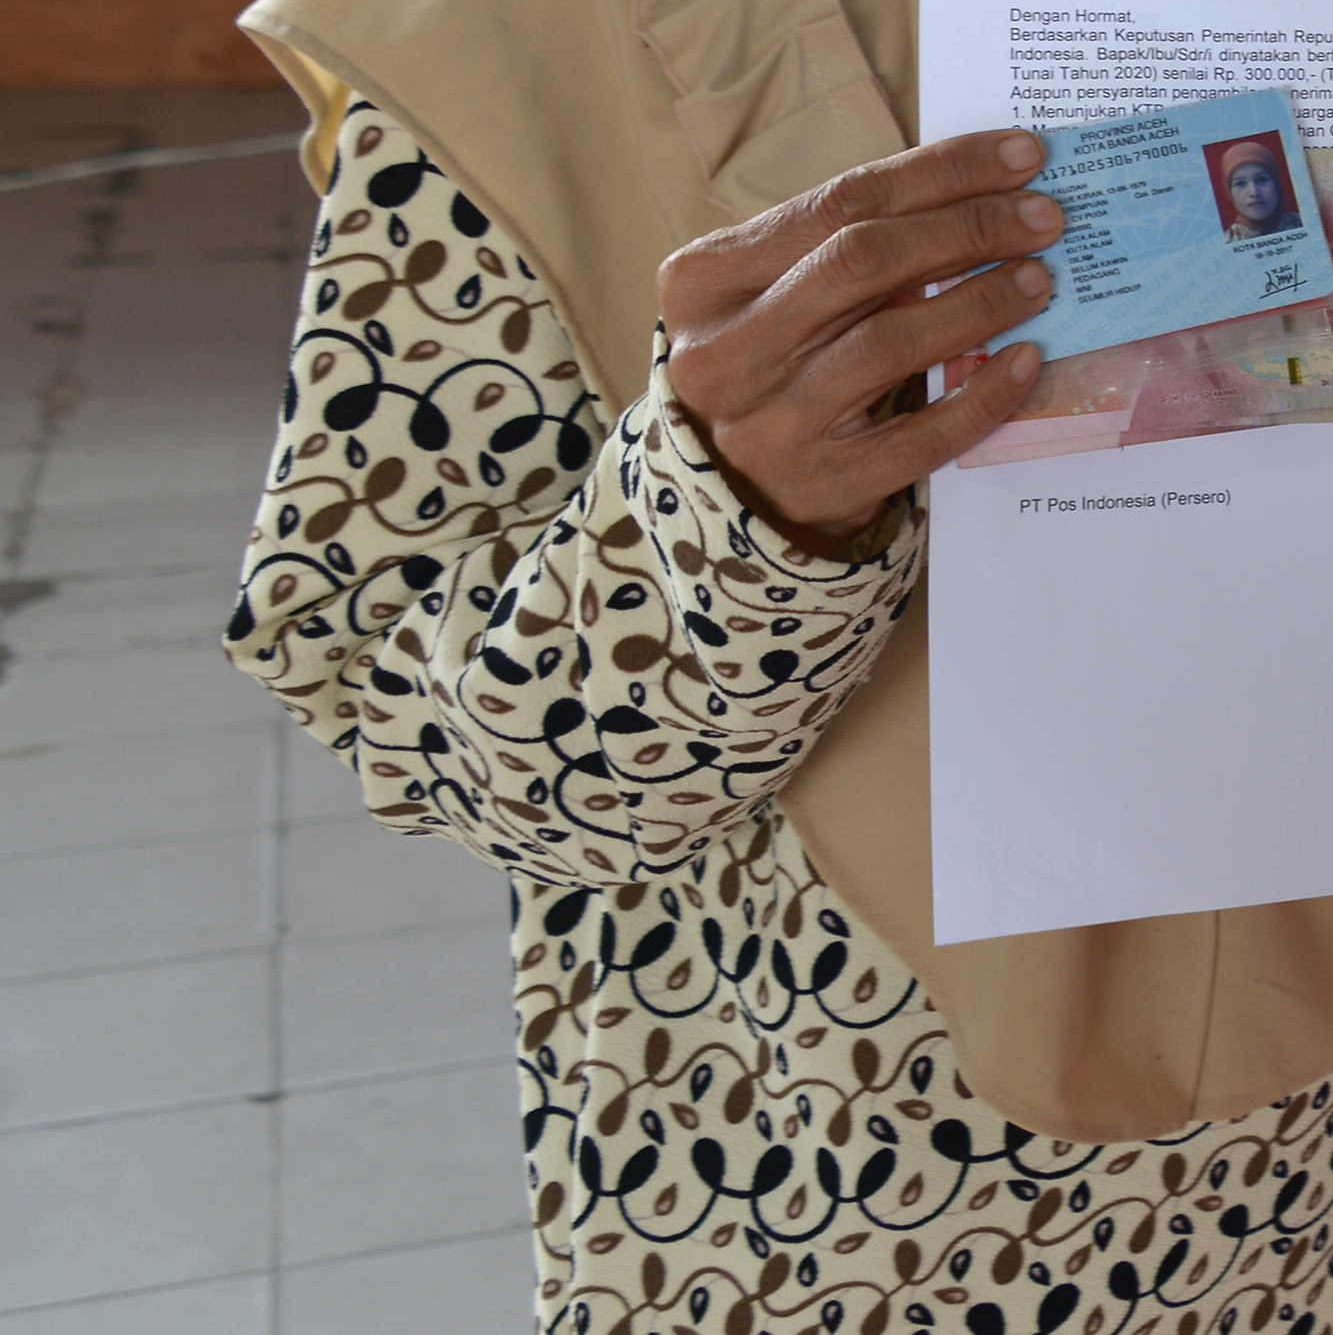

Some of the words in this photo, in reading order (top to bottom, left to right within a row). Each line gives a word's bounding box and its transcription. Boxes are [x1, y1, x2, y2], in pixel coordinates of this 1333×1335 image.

[1010, 8, 1070, 25] Dengan
[1075, 8, 1136, 25] Hormat,
[1010, 28, 1107, 42] Berdasarkan
[1114, 28, 1195, 46] Keputusan
[1201, 29, 1287, 44] Pemerintah
[1010, 47, 1088, 62] Indonesia.
[1097, 48, 1213, 64] Bapak/Ibu/Sdr/i
[1218, 49, 1300, 65] dinyatakan
[1010, 66, 1055, 80] Tunai
[1059, 66, 1110, 80] Tahun
[1114, 66, 1158, 82] 2020)
[1162, 67, 1209, 81] senilai
[1213, 67, 1240, 83] Rp.
[1244, 67, 1316, 83] 300.000,-
[1010, 86, 1071, 102] Adapun
[1076, 86, 1168, 103] persyaratan
[1012, 106, 1025, 118] 1.
[1031, 105, 1126, 121] Menunjukan
[1079, 124, 1135, 143] PROVINSI
[1137, 117, 1168, 131] ACEH
[1073, 143, 1106, 156] KOTA
[1107, 134, 1147, 150] BANDA
[1148, 127, 1180, 141] ACEH
[1040, 142, 1188, 182] 1171025306790006
[1019, 498, 1042, 514] PT
[1047, 497, 1077, 513] Pos
[1081, 493, 1156, 511] Indonesia
[1161, 489, 1232, 510] (Persero)
